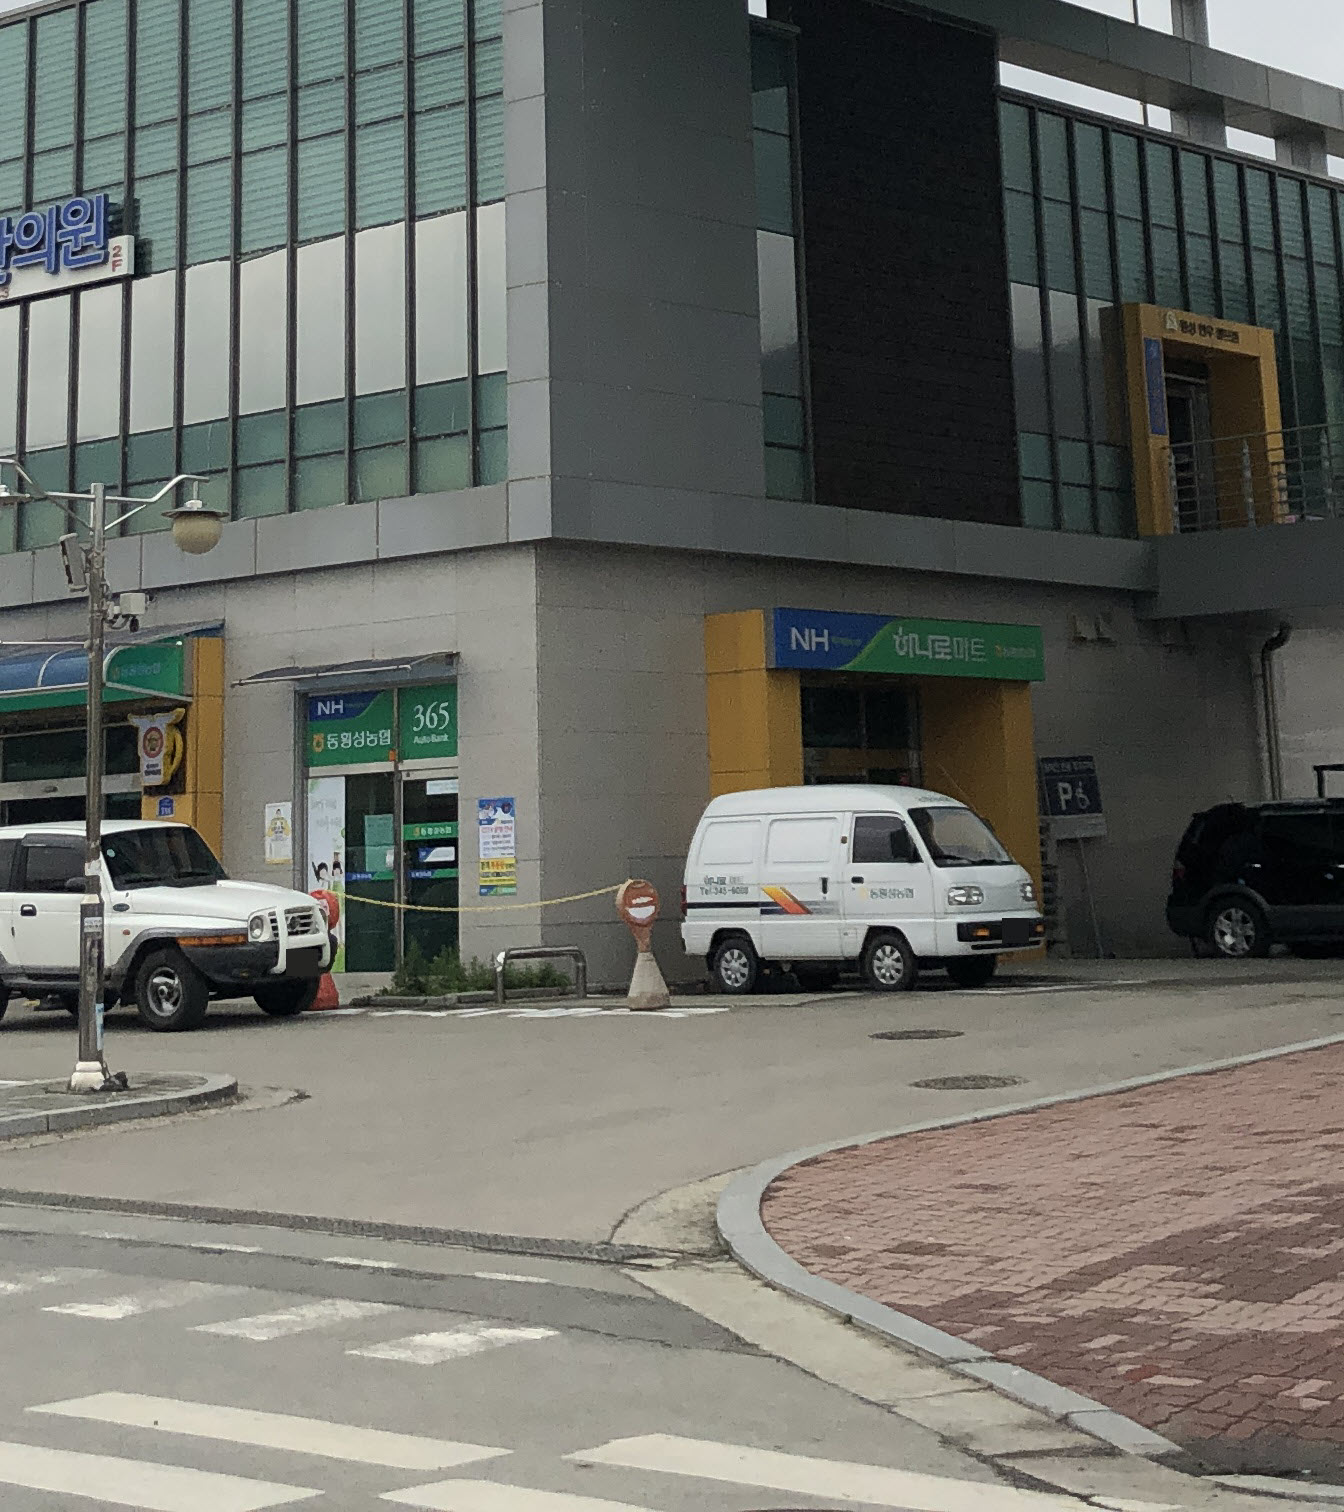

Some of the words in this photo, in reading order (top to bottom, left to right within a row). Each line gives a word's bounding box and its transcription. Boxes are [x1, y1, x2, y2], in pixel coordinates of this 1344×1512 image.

[791, 627, 829, 652] NH
[892, 627, 987, 662] 하나로마트
[317, 699, 344, 716] NH
[412, 700, 450, 732] 365
[326, 729, 392, 751] 동횡성농협
[1057, 782, 1073, 811] P
